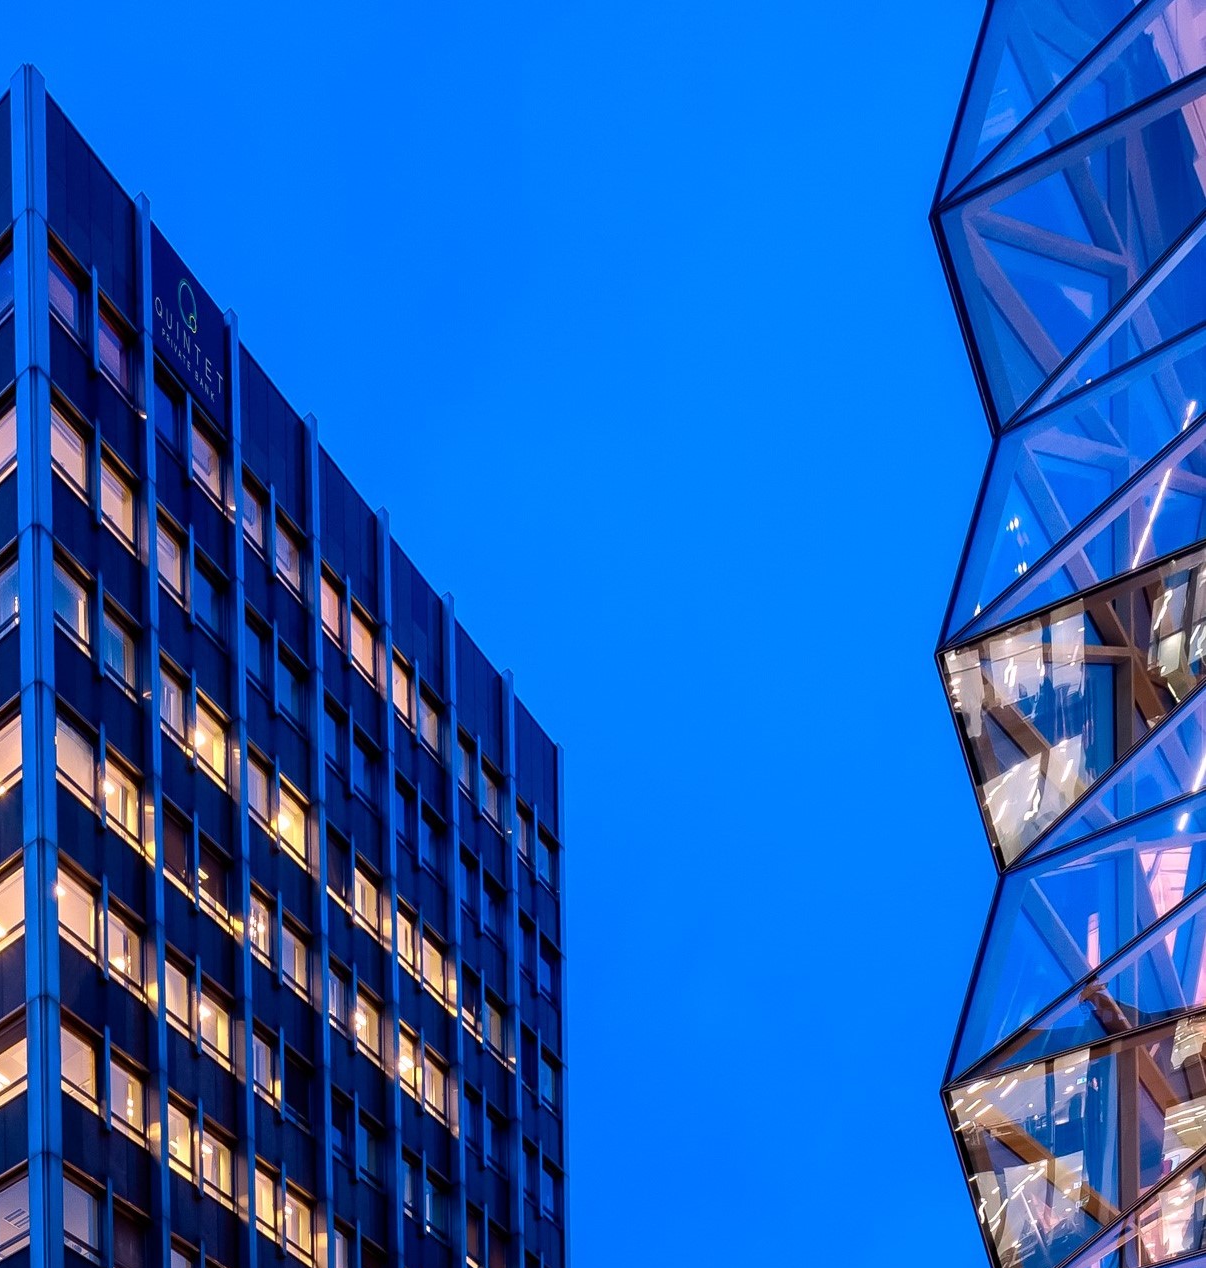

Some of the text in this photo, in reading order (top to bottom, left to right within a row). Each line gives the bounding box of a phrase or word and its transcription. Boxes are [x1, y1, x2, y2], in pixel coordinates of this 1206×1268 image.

[154, 296, 223, 394] QUINTET
[161, 327, 215, 402] PRIVATE BANK
